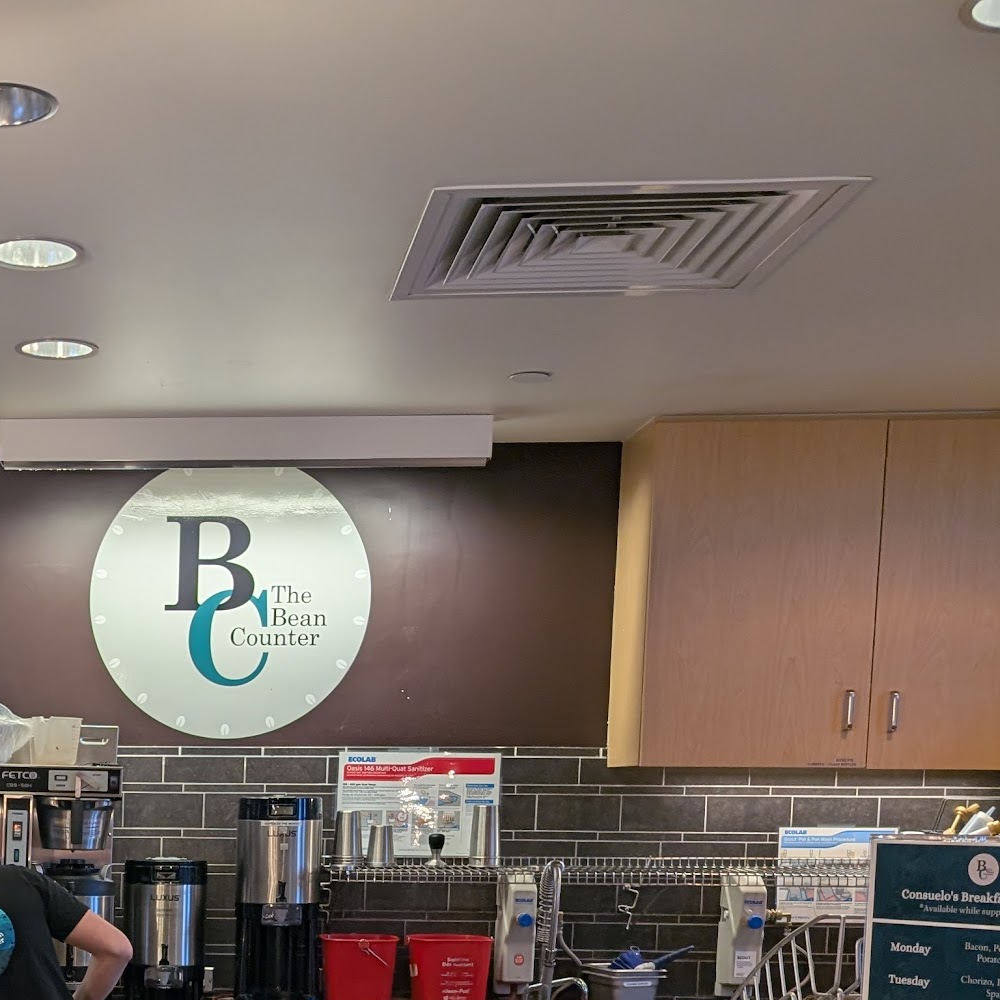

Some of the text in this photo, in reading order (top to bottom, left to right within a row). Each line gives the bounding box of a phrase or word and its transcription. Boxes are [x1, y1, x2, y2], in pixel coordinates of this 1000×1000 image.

[271, 585, 312, 604] The
[271, 608, 327, 627] Bean
[230, 627, 320, 647] Counter
[1, 770, 37, 780] FETCO
[376, 765, 406, 773] Multi-Quat
[902, 888, 959, 902] Consuelo's
[959, 906, 980, 915] while
[890, 941, 931, 956] Monday
[964, 941, 991, 953] Bacon,
[888, 973, 930, 989] Tuesday
[960, 974, 995, 987] Chorizo,
